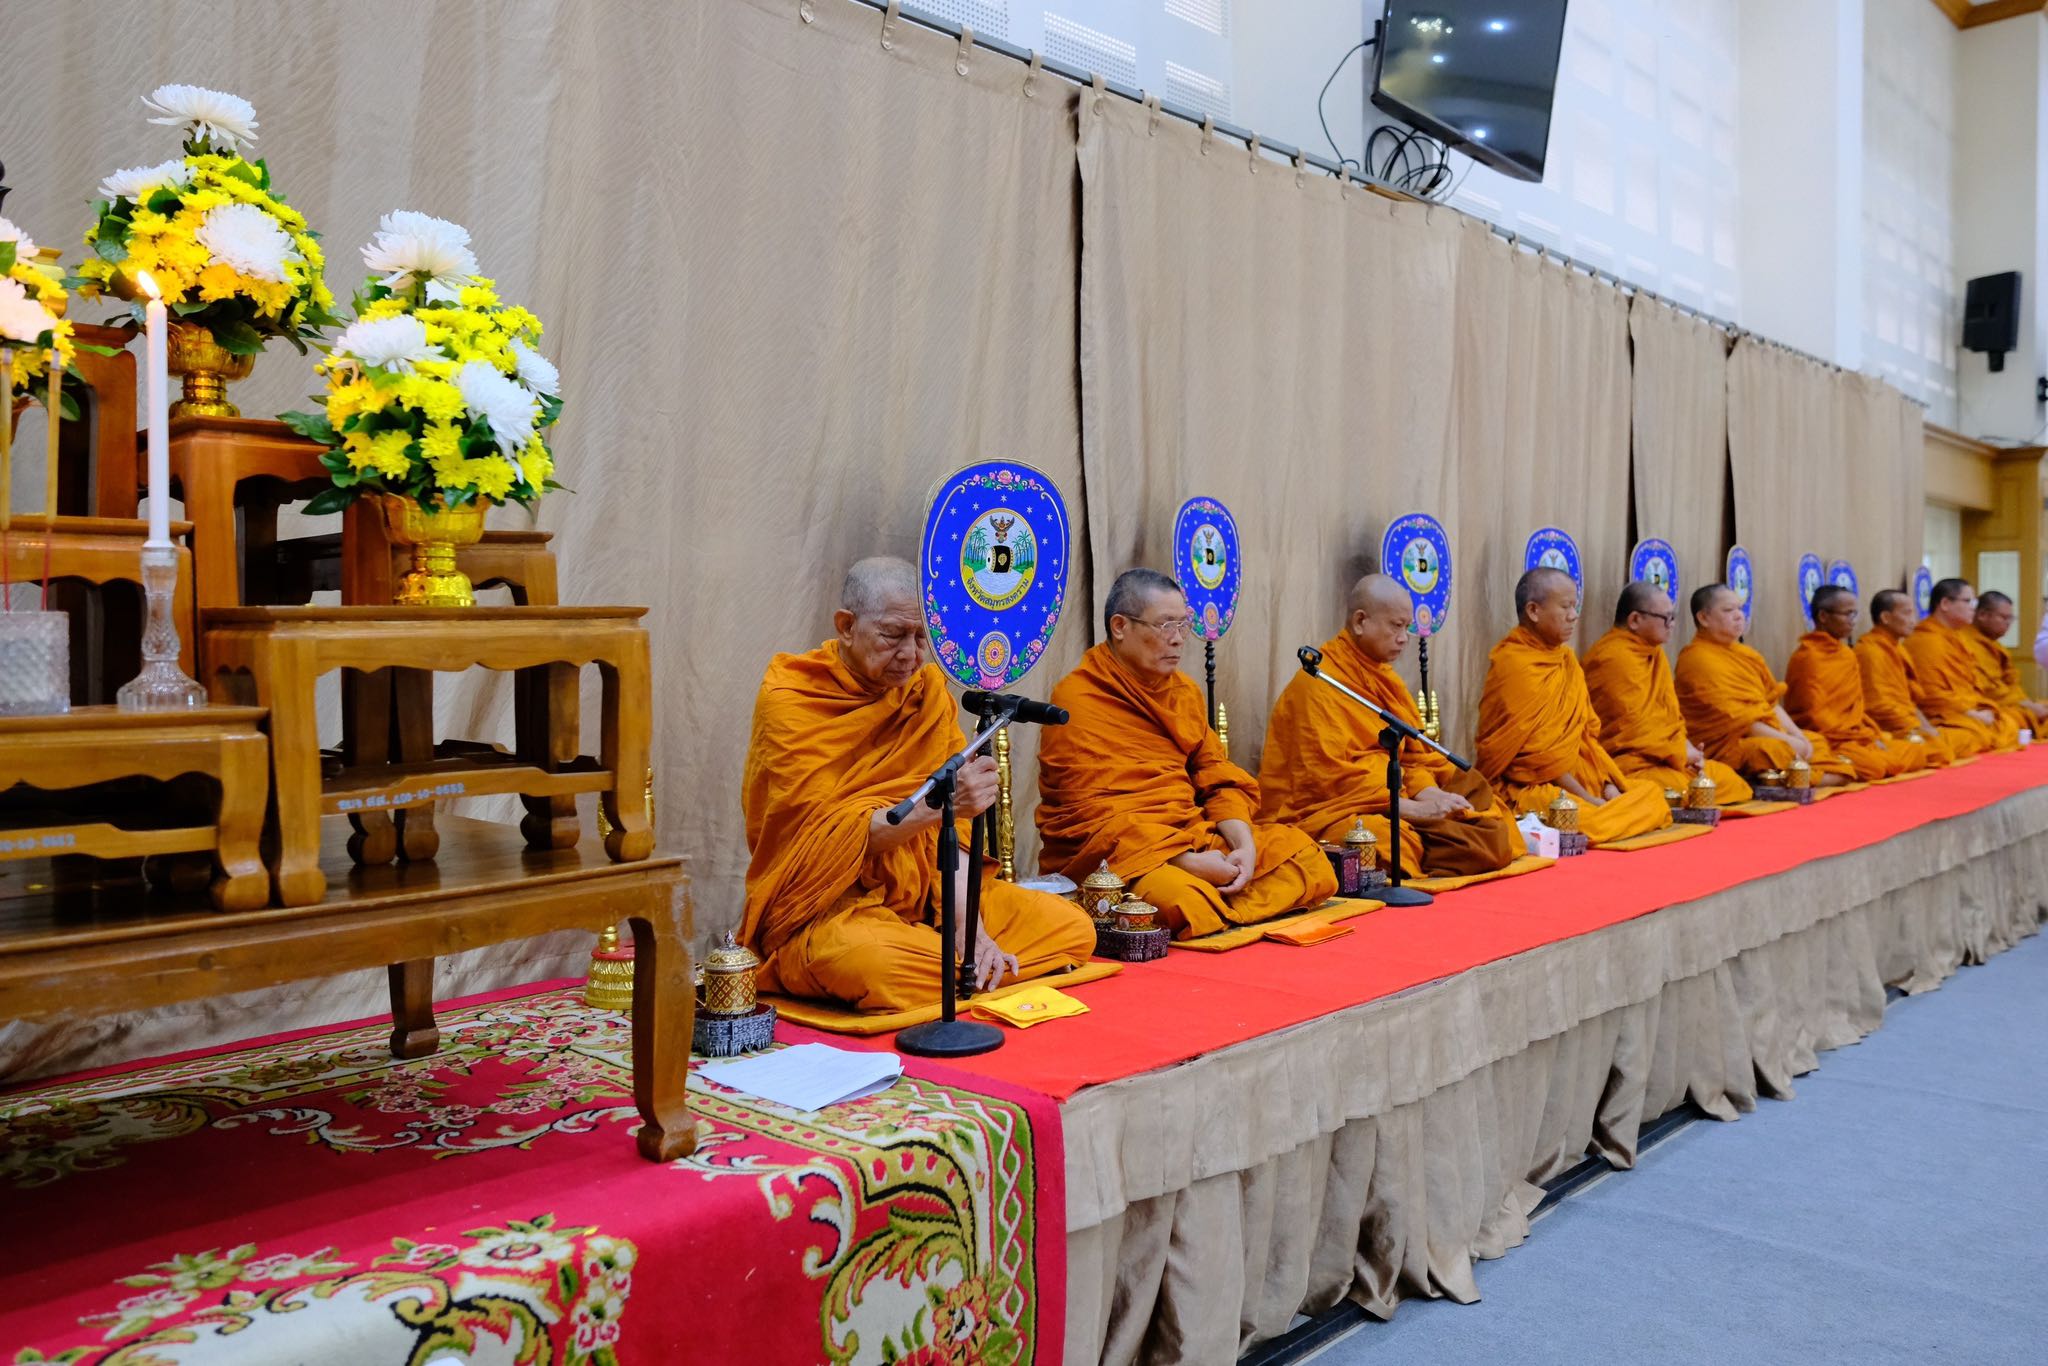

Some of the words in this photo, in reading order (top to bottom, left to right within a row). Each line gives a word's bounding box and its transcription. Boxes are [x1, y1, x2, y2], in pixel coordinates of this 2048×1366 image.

[967, 577, 1029, 609] จังหวัดสมุทรสงคราม
